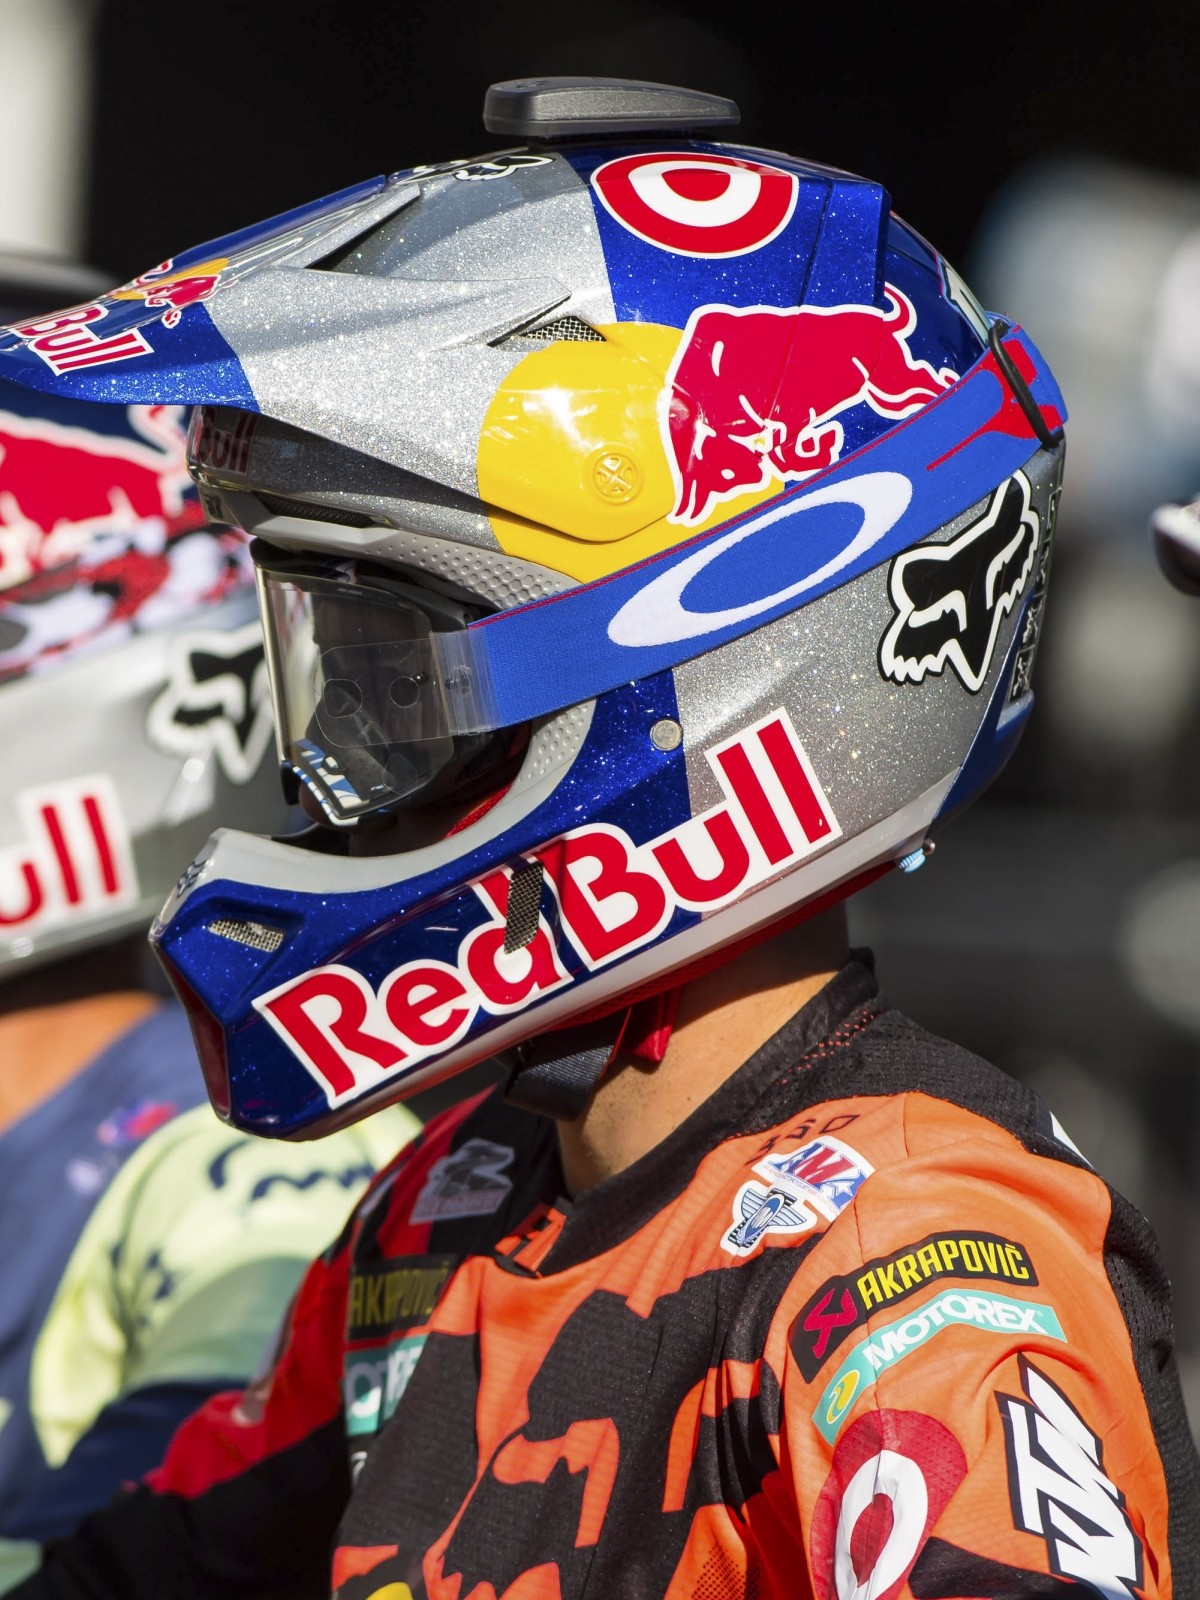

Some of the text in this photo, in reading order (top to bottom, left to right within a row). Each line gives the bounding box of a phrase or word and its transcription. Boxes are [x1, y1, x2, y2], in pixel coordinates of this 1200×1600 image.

[11, 304, 148, 372] Bull
[264, 718, 832, 1098] Red Bull
[767, 1141, 869, 1212] AMA
[857, 1239, 1030, 1311] AKRAPOVIČ
[863, 1294, 1049, 1370] MOTOREX
[1000, 1360, 1141, 1600] KTM
